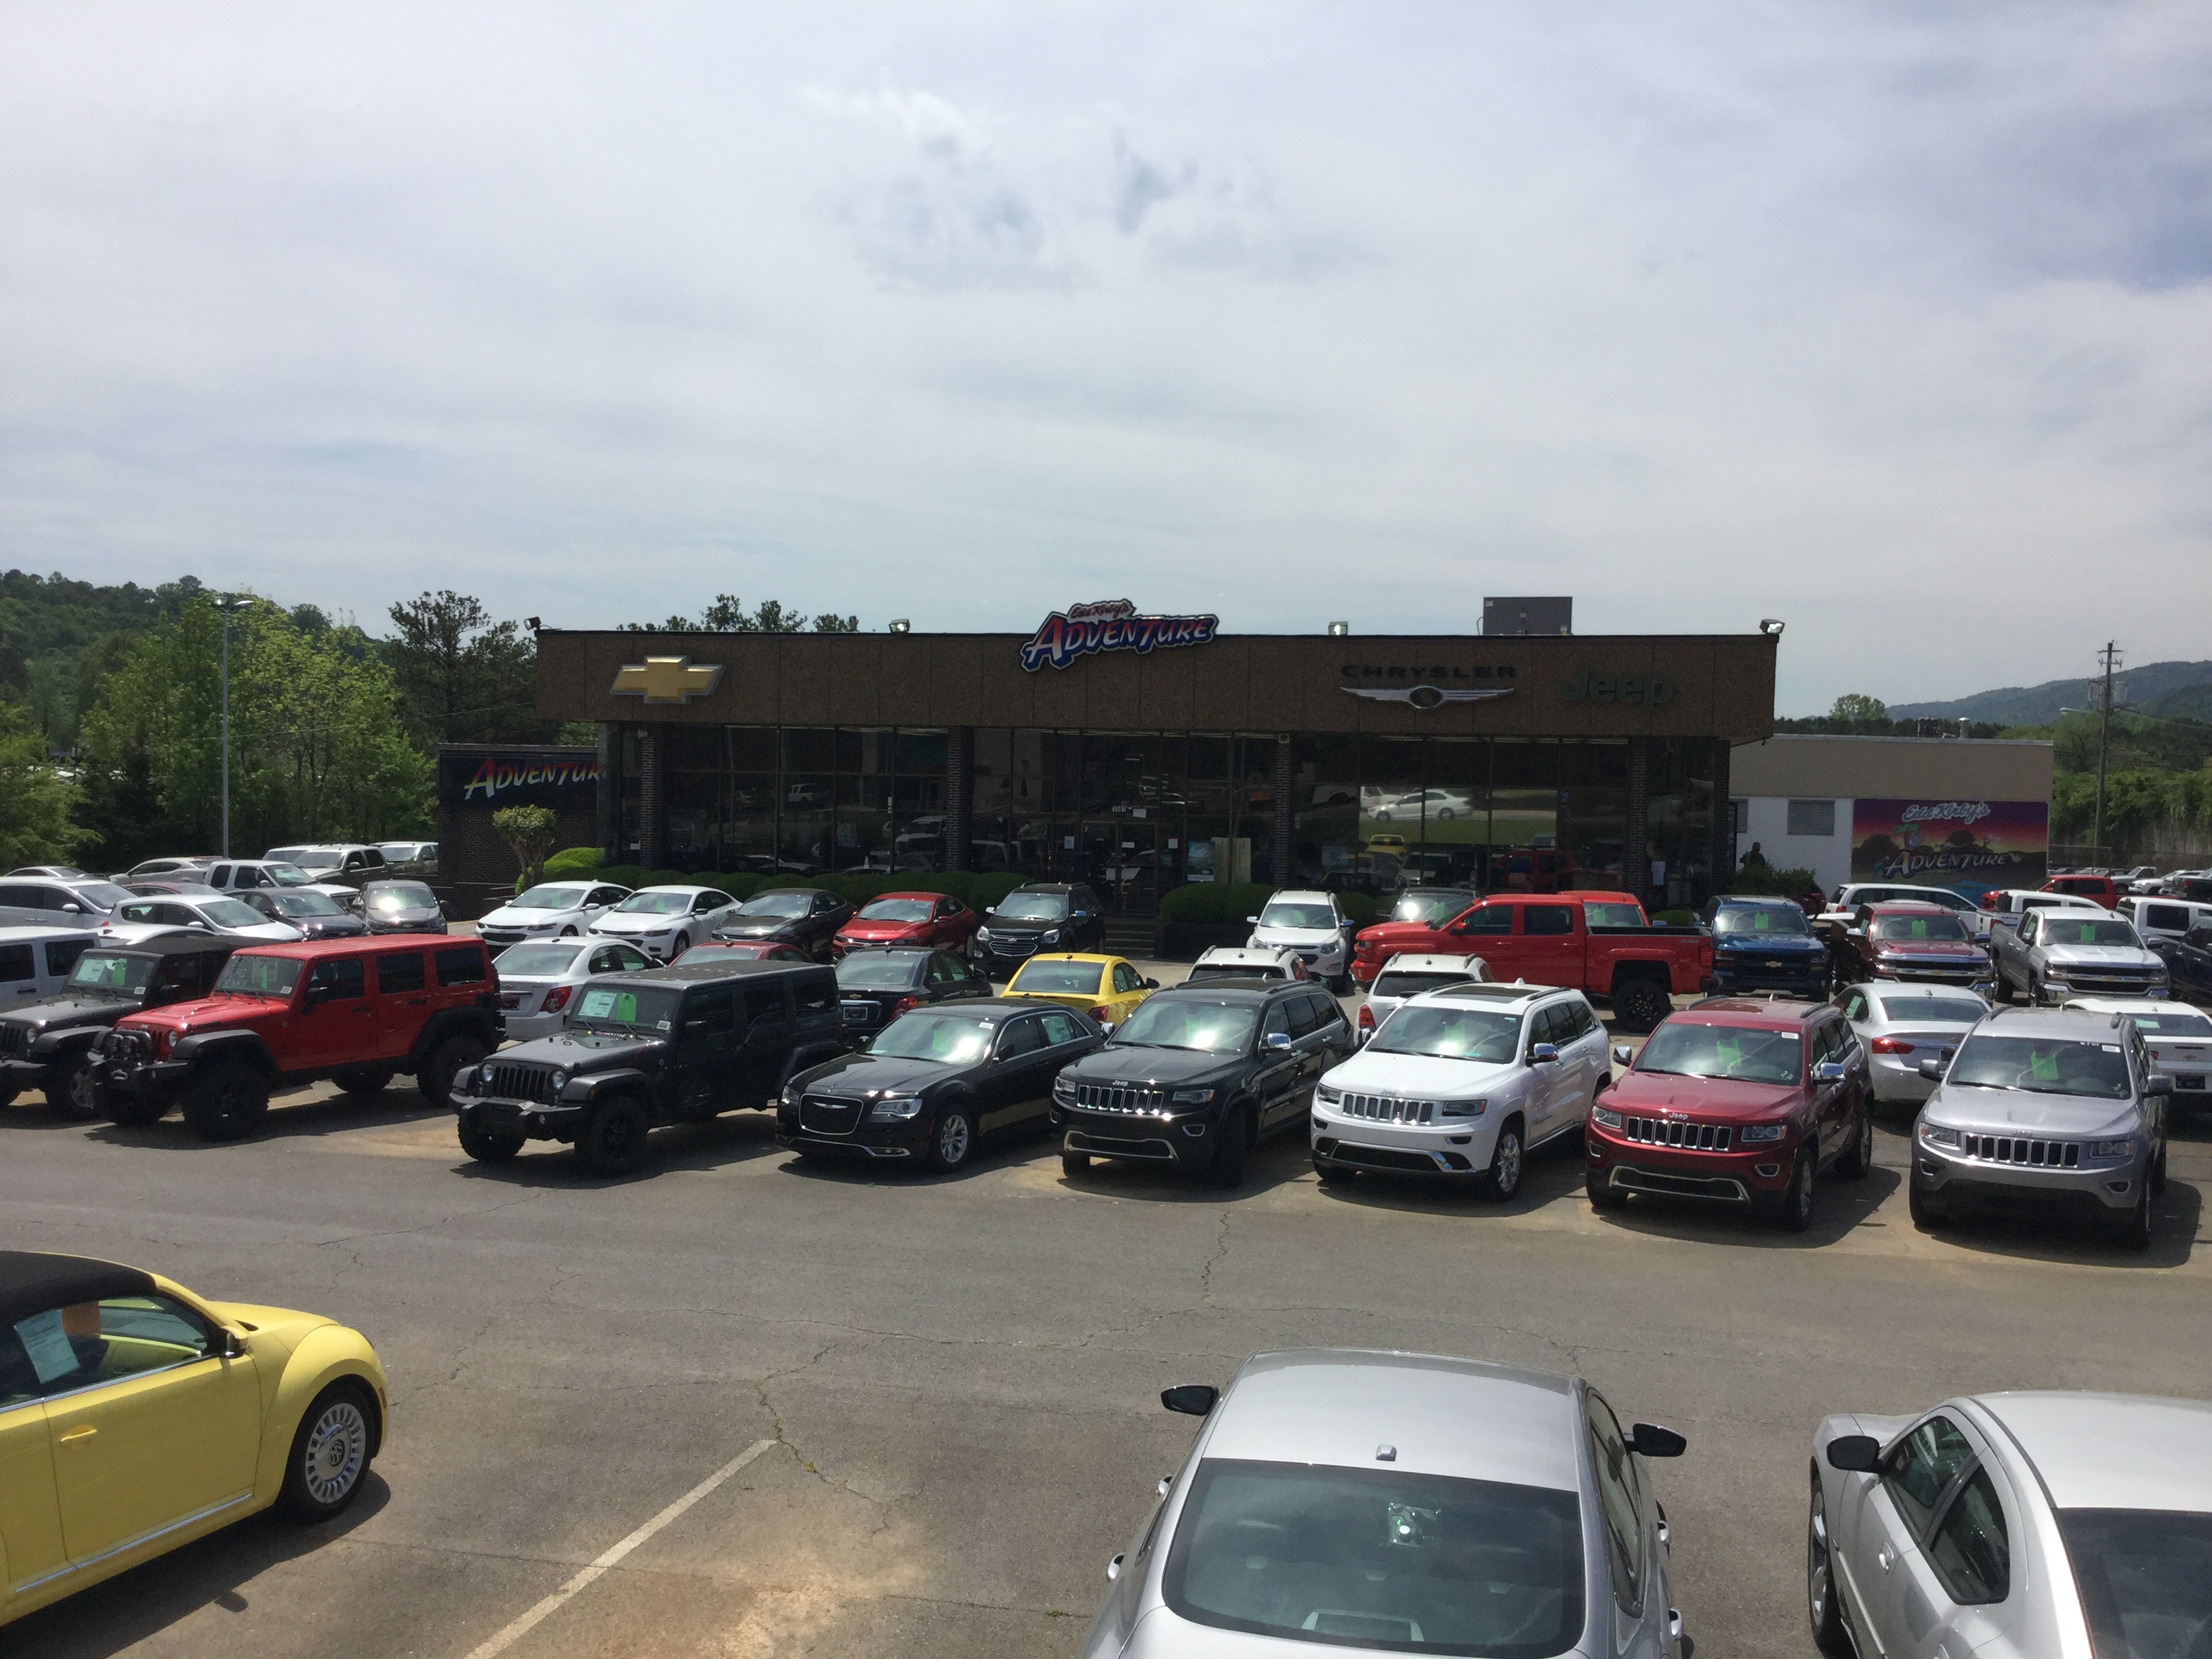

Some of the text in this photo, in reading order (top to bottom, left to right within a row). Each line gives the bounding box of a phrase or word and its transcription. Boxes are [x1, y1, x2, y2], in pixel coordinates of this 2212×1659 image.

[1025, 617, 1213, 665] ADVENTURE
[1340, 664, 1517, 679] CHRYSLER
[1558, 659, 1674, 710] Jeep
[463, 759, 607, 800] ADVENTUR
[1885, 851, 2007, 877] ADVENTURE
[1668, 1112, 1688, 1120] Jeep
